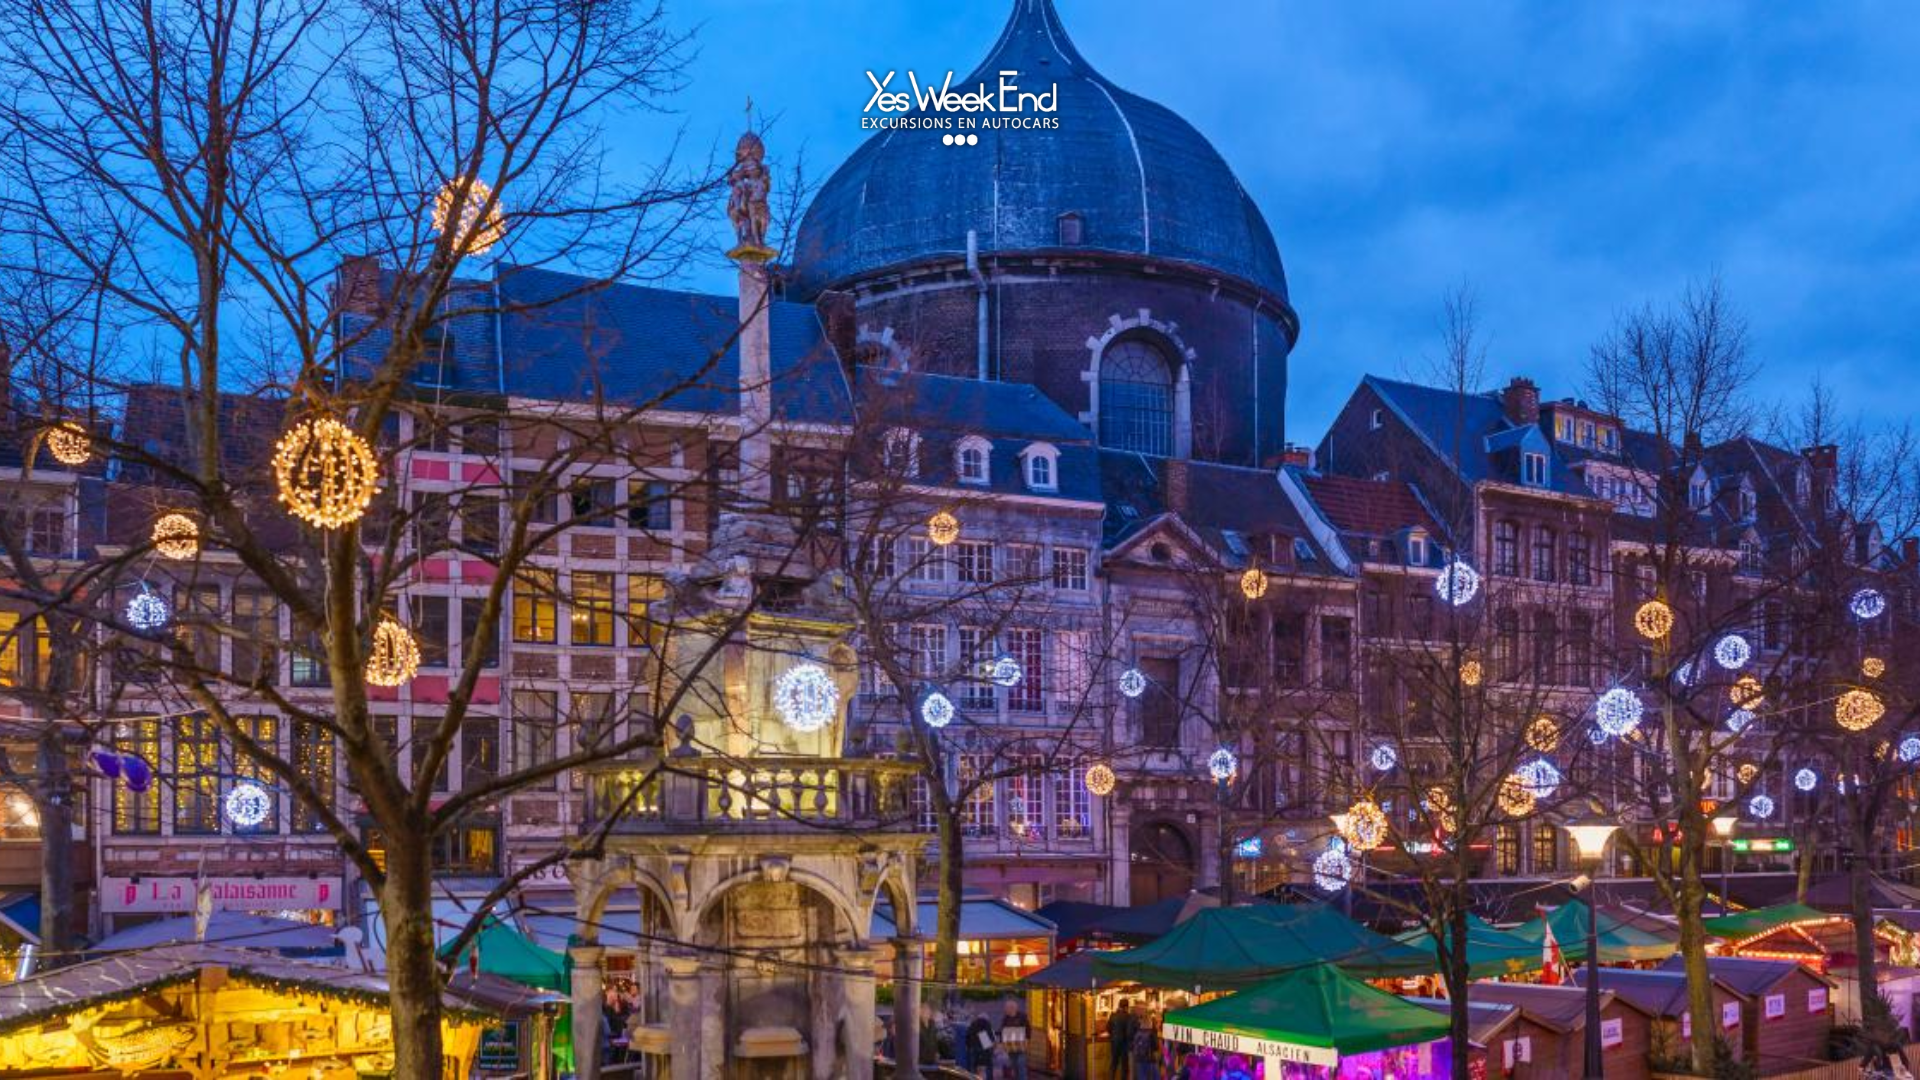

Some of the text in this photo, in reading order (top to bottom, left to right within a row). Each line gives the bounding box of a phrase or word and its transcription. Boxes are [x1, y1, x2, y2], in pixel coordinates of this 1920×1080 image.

[195, 881, 297, 900] alaisanne
[1172, 1024, 1310, 1062] VIN CHAUD ALSACIEN
